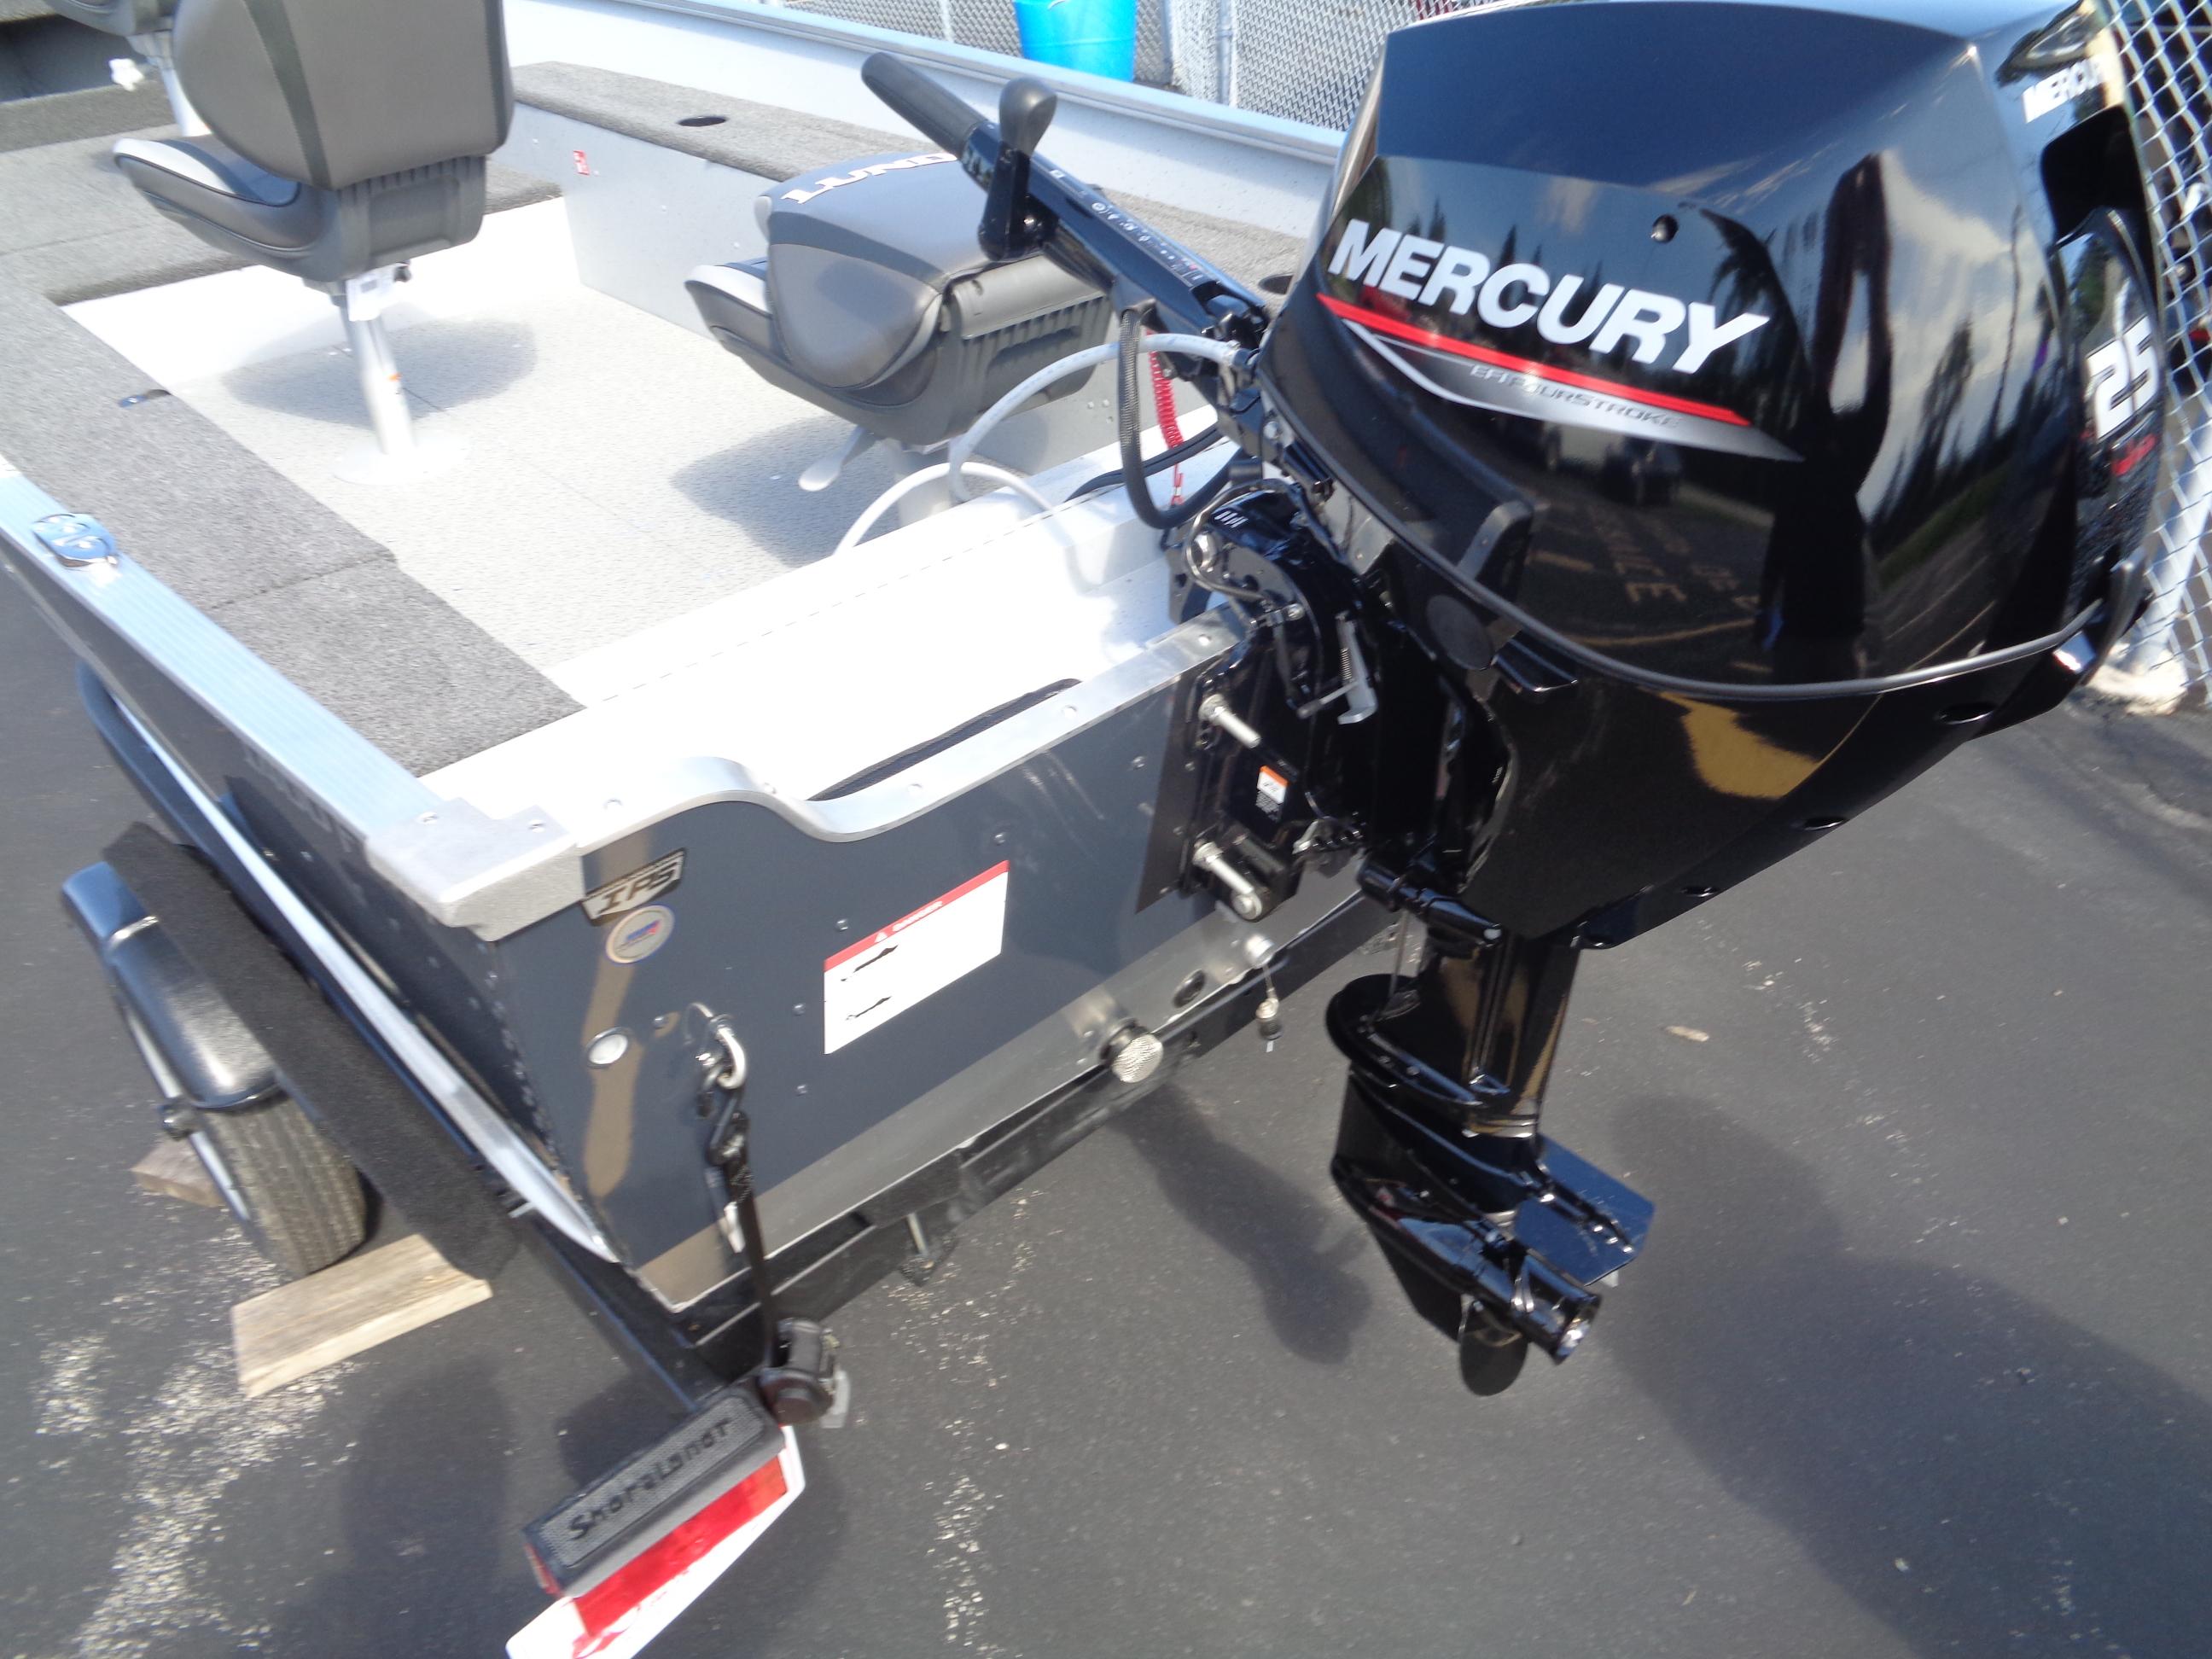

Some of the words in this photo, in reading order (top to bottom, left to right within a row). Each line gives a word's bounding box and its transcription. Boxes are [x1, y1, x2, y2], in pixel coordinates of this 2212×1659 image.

[780, 152, 958, 205] LUND
[1328, 218, 1770, 374] MERCURY
[2085, 314, 2159, 444] 25
